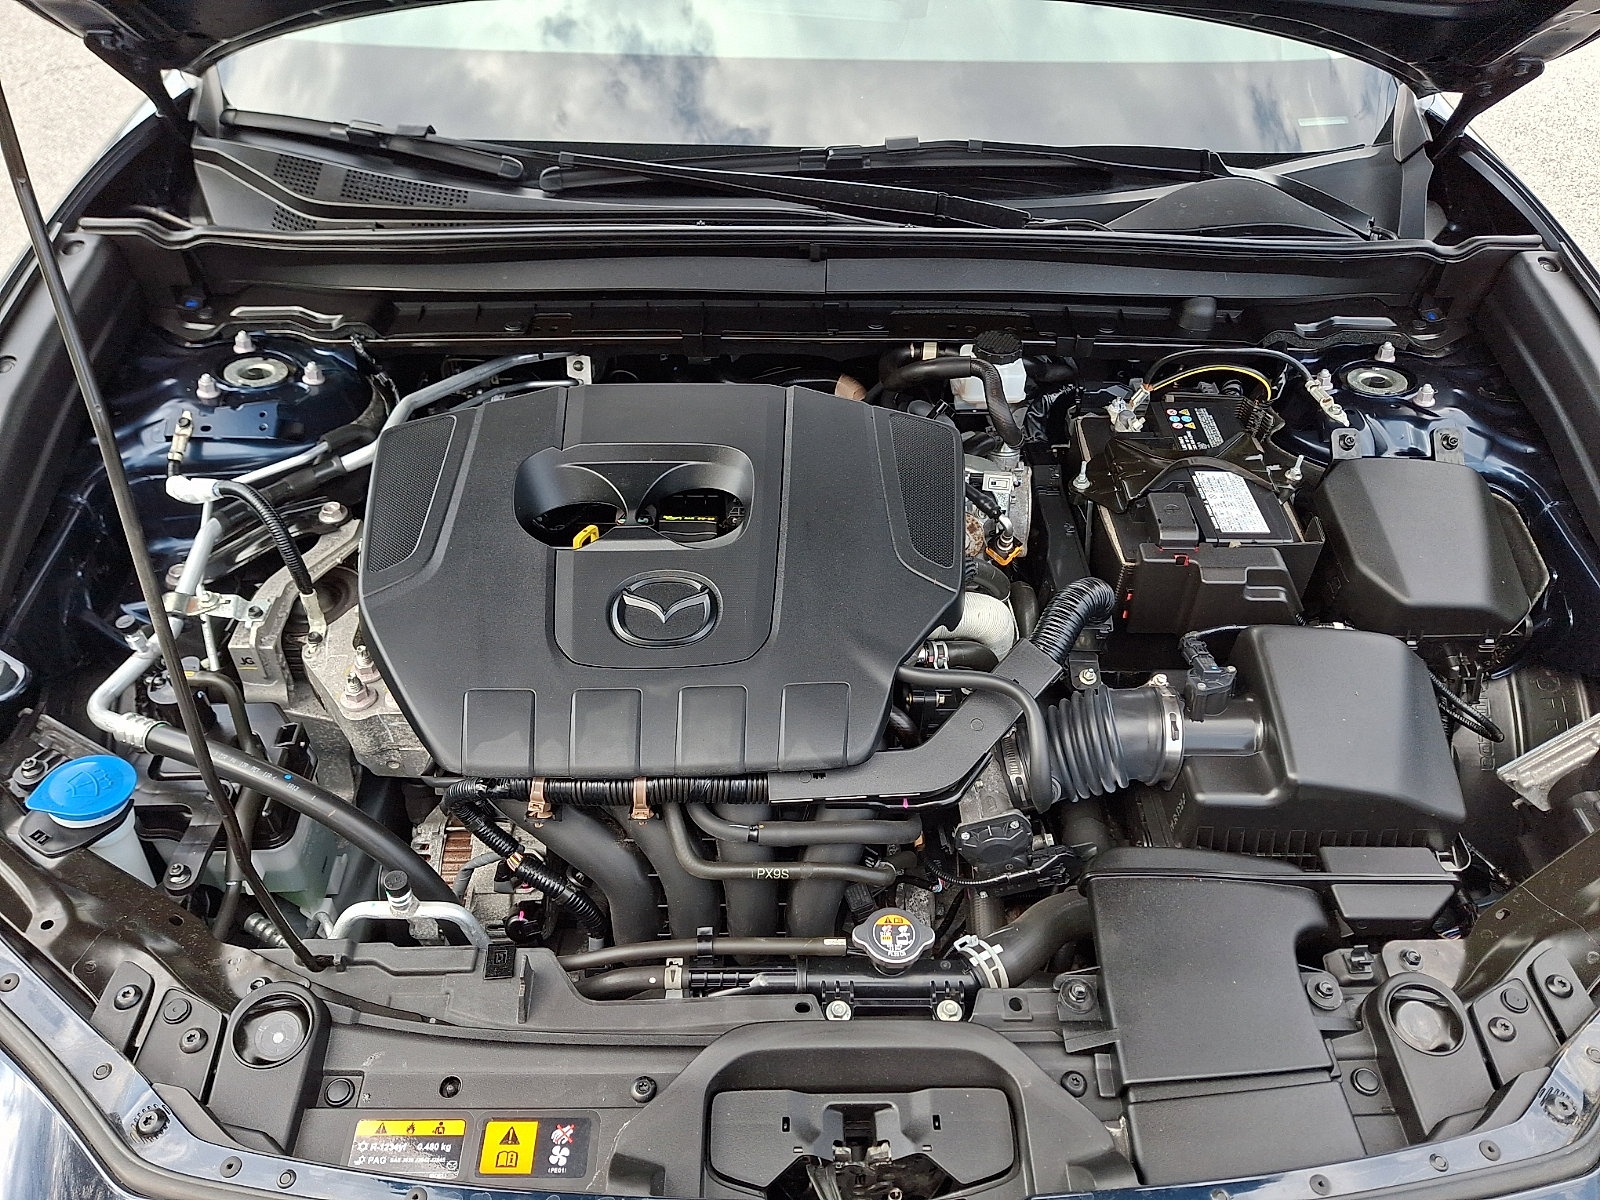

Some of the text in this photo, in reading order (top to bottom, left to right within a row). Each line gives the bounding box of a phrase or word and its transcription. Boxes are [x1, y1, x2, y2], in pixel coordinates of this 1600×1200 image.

[756, 867, 790, 880] PX9S
[416, 1142, 440, 1152] 0.480
[441, 1142, 452, 1153] kg
[367, 1156, 388, 1165] PAG
